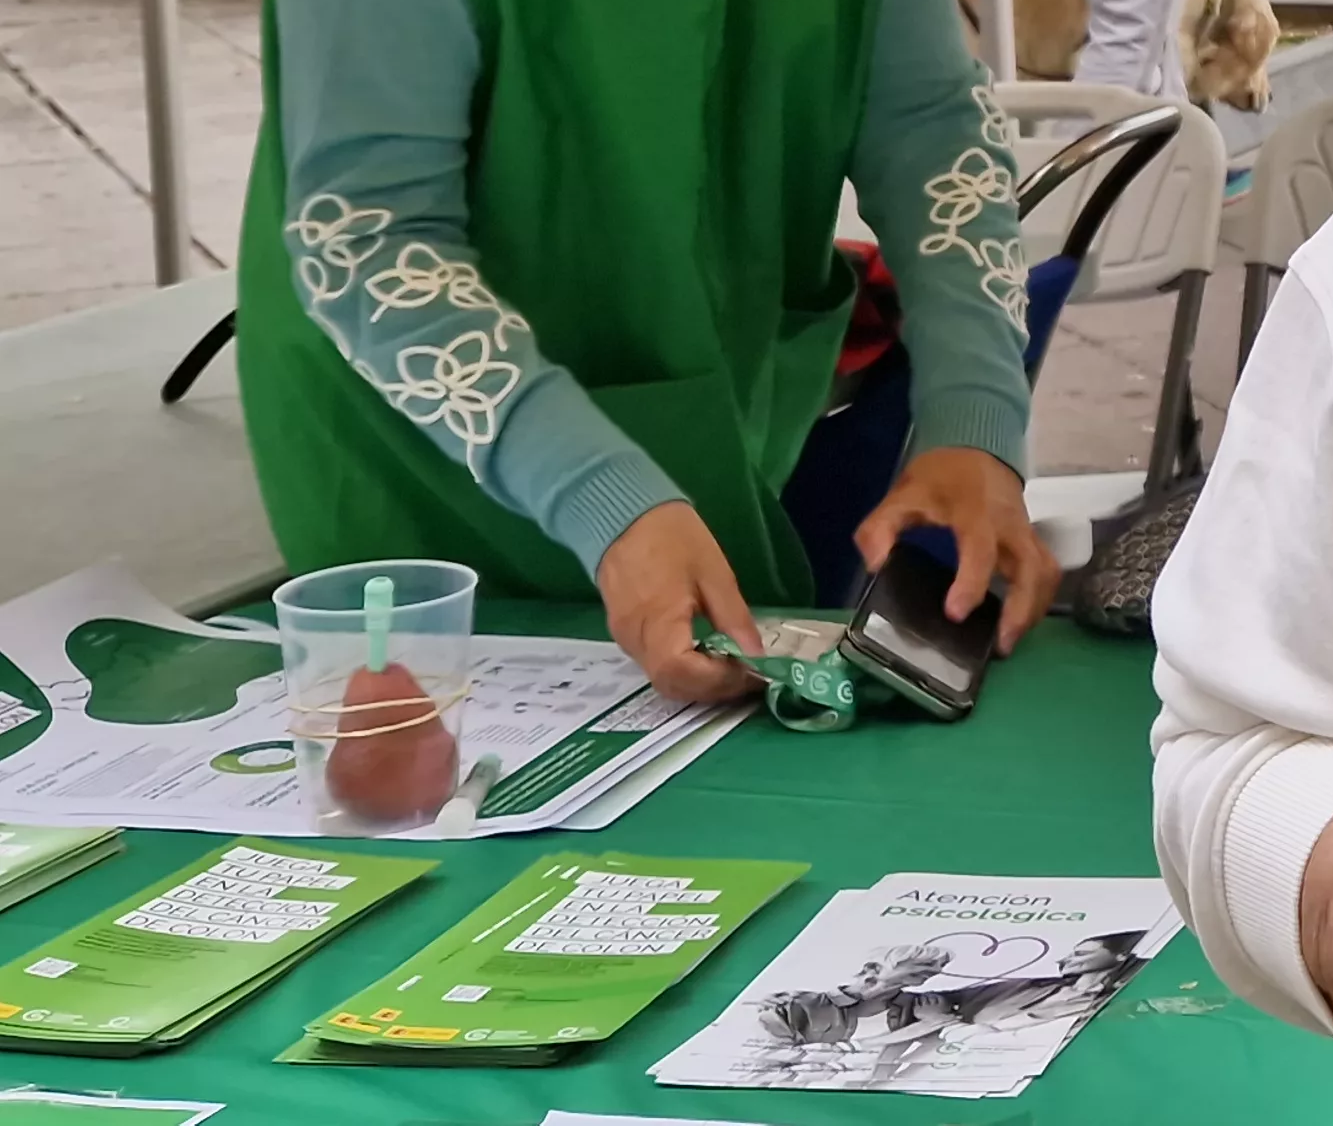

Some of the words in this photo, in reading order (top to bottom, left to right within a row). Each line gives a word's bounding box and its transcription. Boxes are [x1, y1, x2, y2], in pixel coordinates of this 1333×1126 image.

[240, 852, 324, 873] JUEGA
[195, 876, 237, 892] EN
[221, 863, 259, 879] TU
[259, 872, 338, 888] PAPEL
[600, 875, 681, 889] JUEGA
[583, 888, 620, 899] TU
[623, 889, 704, 902] PAPEL
[895, 889, 1052, 907] Atención
[149, 900, 197, 918] DEL
[562, 900, 606, 912] EN
[880, 905, 1088, 924] psicológica
[124, 913, 164, 930] DE
[515, 940, 551, 952] DE
